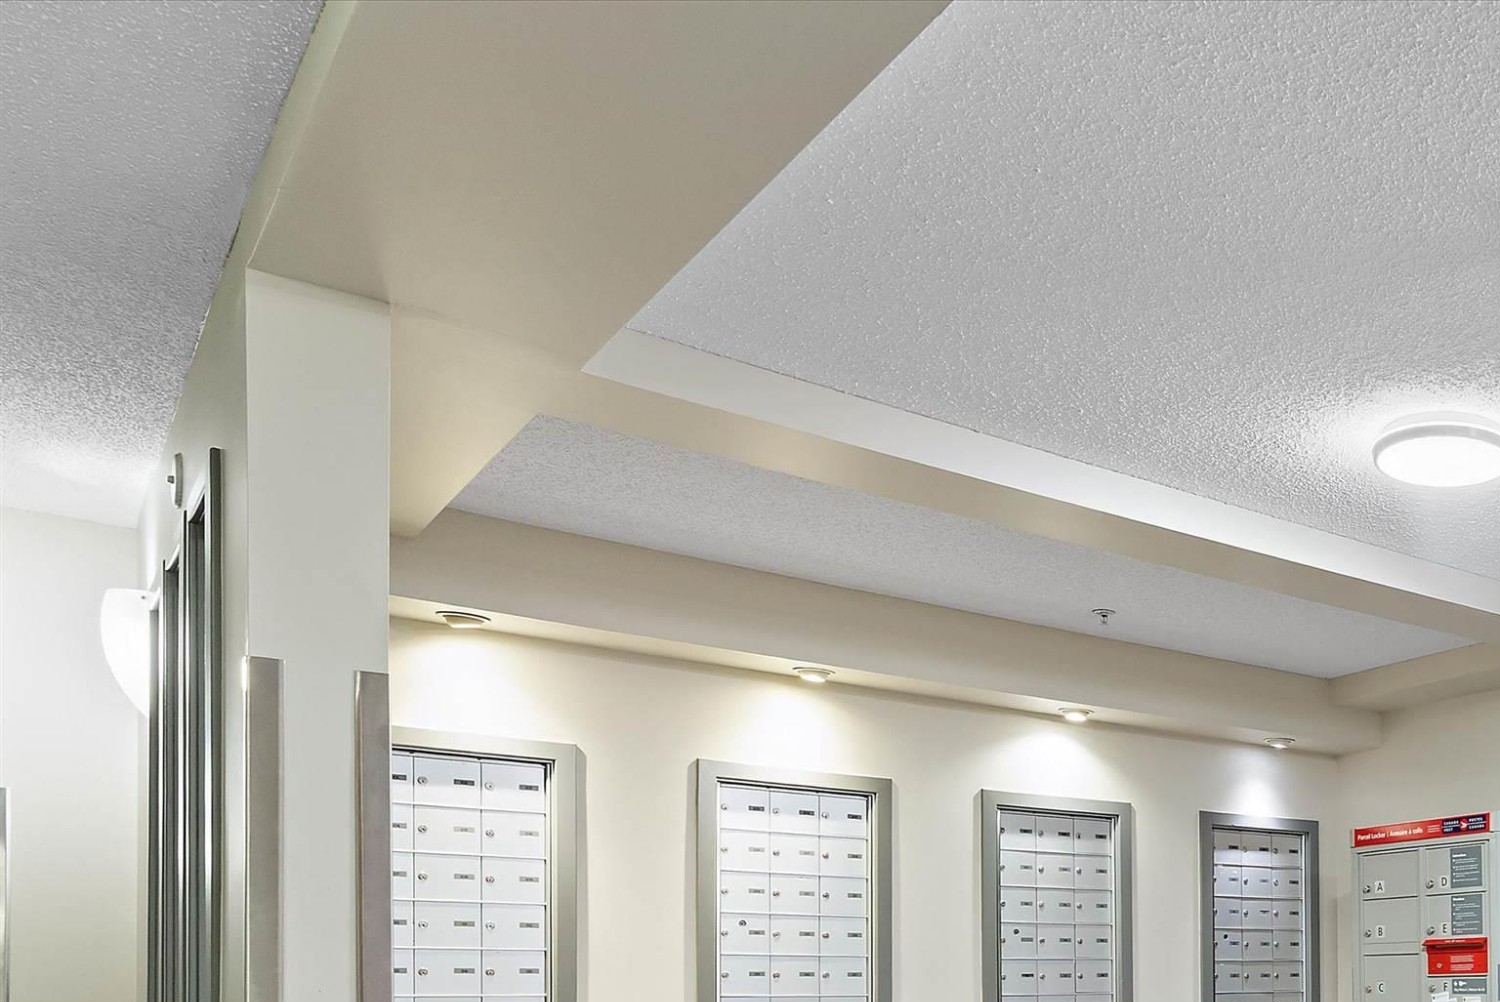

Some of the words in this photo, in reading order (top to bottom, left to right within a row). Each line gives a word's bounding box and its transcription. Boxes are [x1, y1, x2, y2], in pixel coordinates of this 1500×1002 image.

[1357, 833, 1371, 841] Parcel
[1371, 832, 1386, 840] Locker
[1377, 882, 1383, 892] A
[1441, 877, 1447, 887] D
[1378, 927, 1383, 937] B
[1442, 924, 1447, 934] E
[1378, 983, 1384, 993] C
[1443, 982, 1448, 991] F
